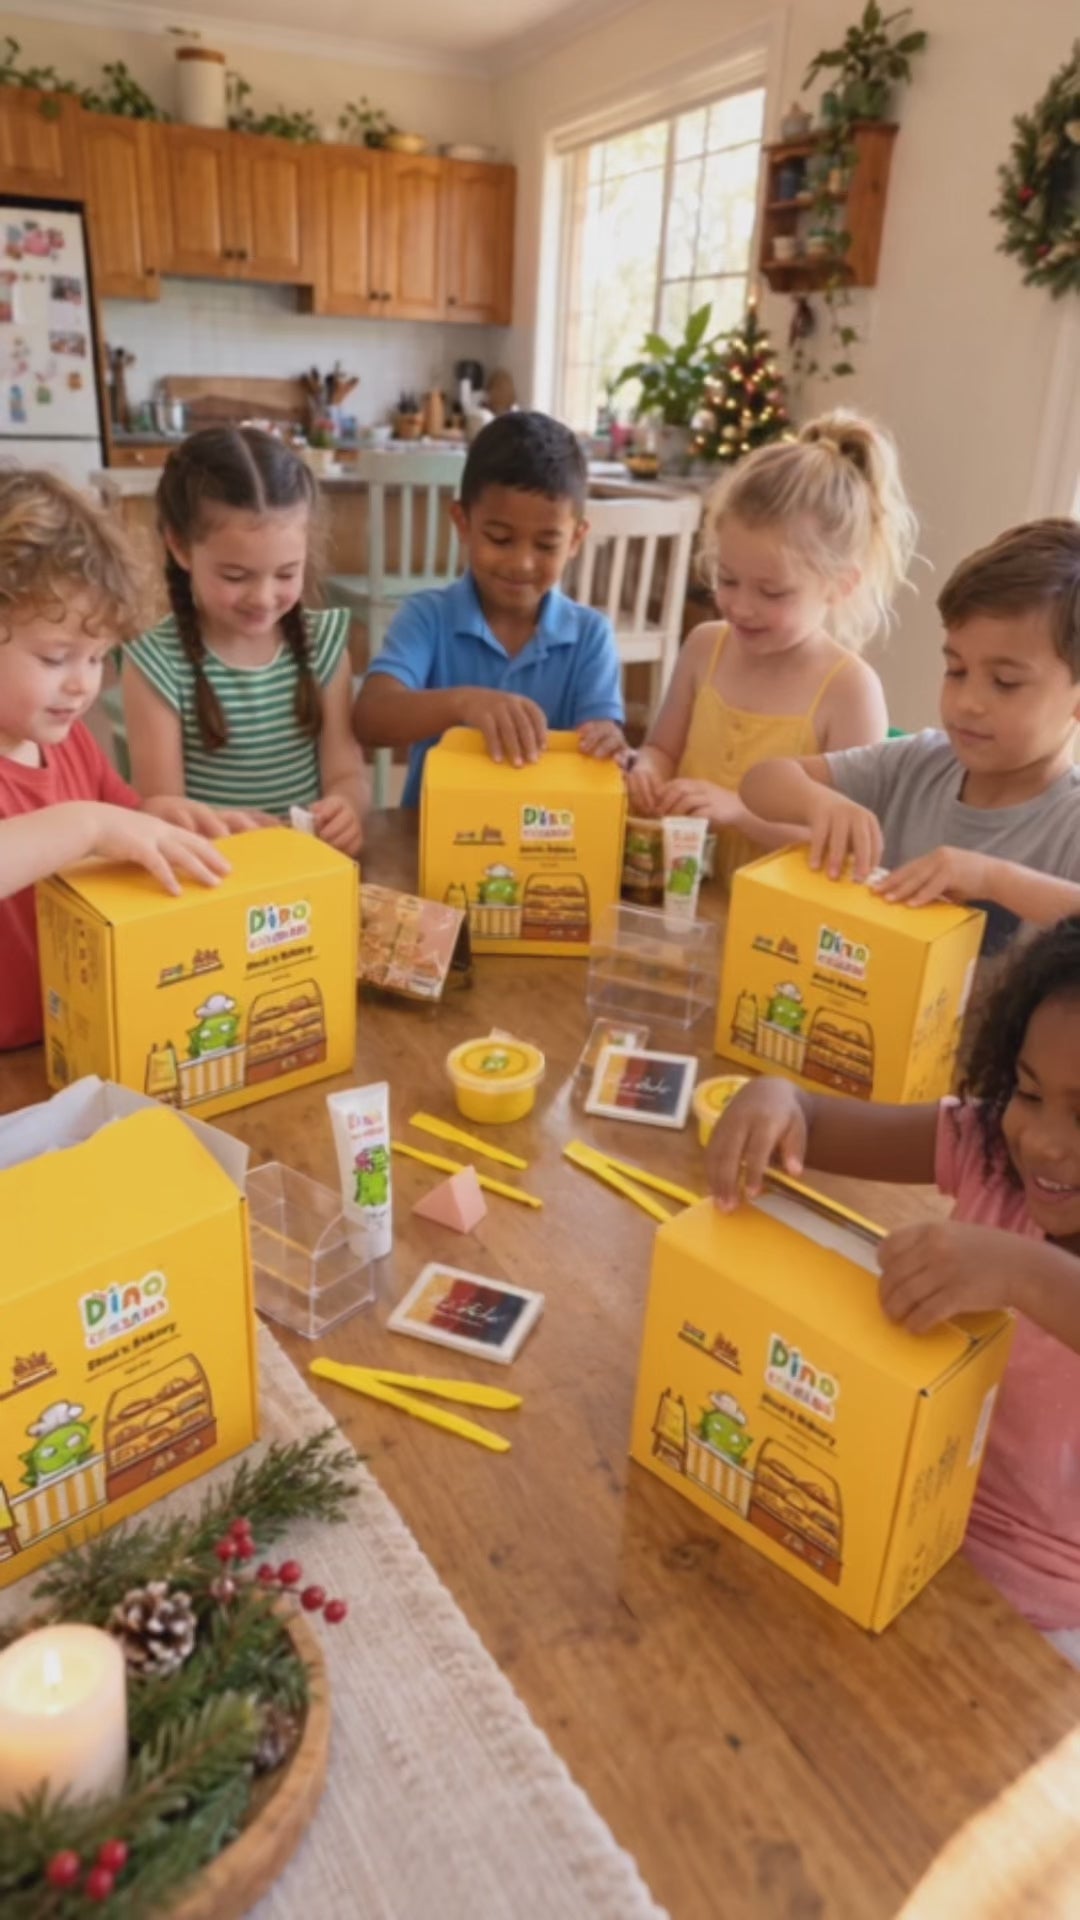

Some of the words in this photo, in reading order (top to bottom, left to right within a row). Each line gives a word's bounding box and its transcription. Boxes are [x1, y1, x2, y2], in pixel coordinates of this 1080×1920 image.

[249, 904, 308, 935] Dino
[84, 1275, 164, 1327] Dino
[770, 1338, 836, 1398] Dino
